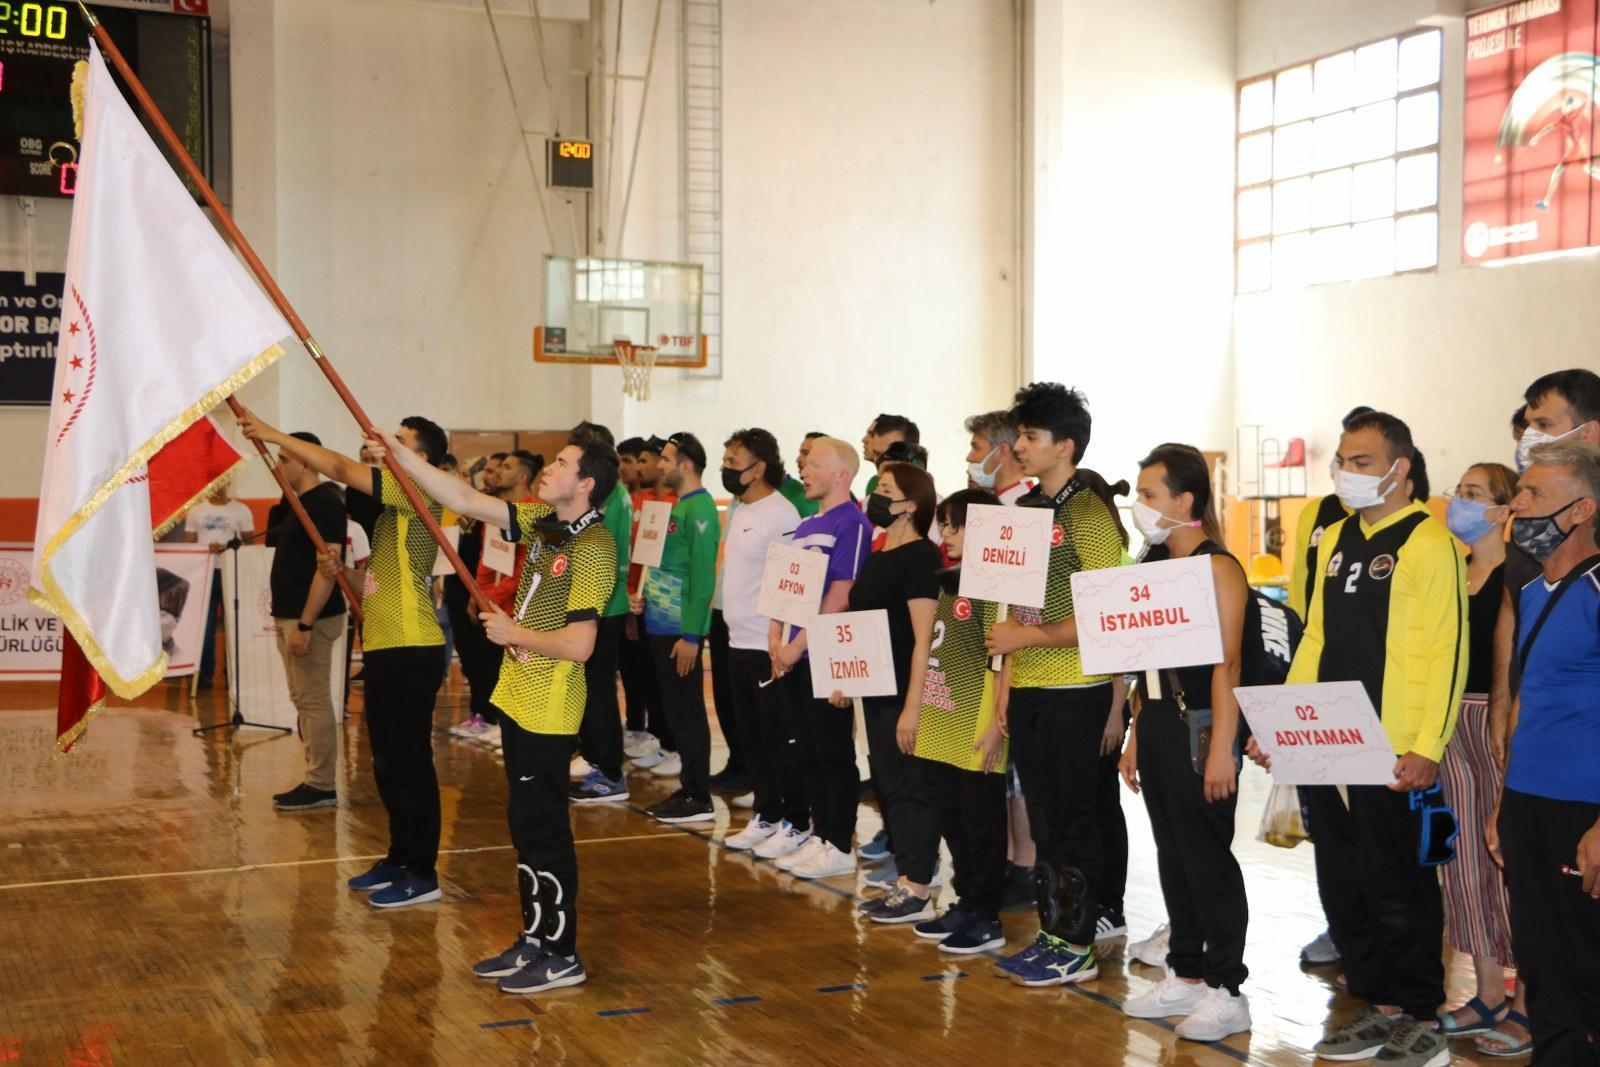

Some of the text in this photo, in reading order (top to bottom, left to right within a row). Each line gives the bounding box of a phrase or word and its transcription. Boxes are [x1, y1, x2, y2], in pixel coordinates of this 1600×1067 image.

[14, 296, 37, 308] ve
[1000, 526, 1013, 541] 20
[982, 546, 1027, 567] DENİZLİ
[790, 562, 800, 575] 03
[1344, 562, 1362, 593] 2
[778, 579, 805, 595] AFYON
[1130, 584, 1151, 603] 34
[1, 614, 57, 631] LİK VE
[1099, 606, 1190, 632] İSTANBUL
[836, 624, 853, 643] 35
[828, 656, 869, 680] İZMİR
[1295, 704, 1318, 721] 02
[1275, 728, 1364, 746] ADIYAMAN
